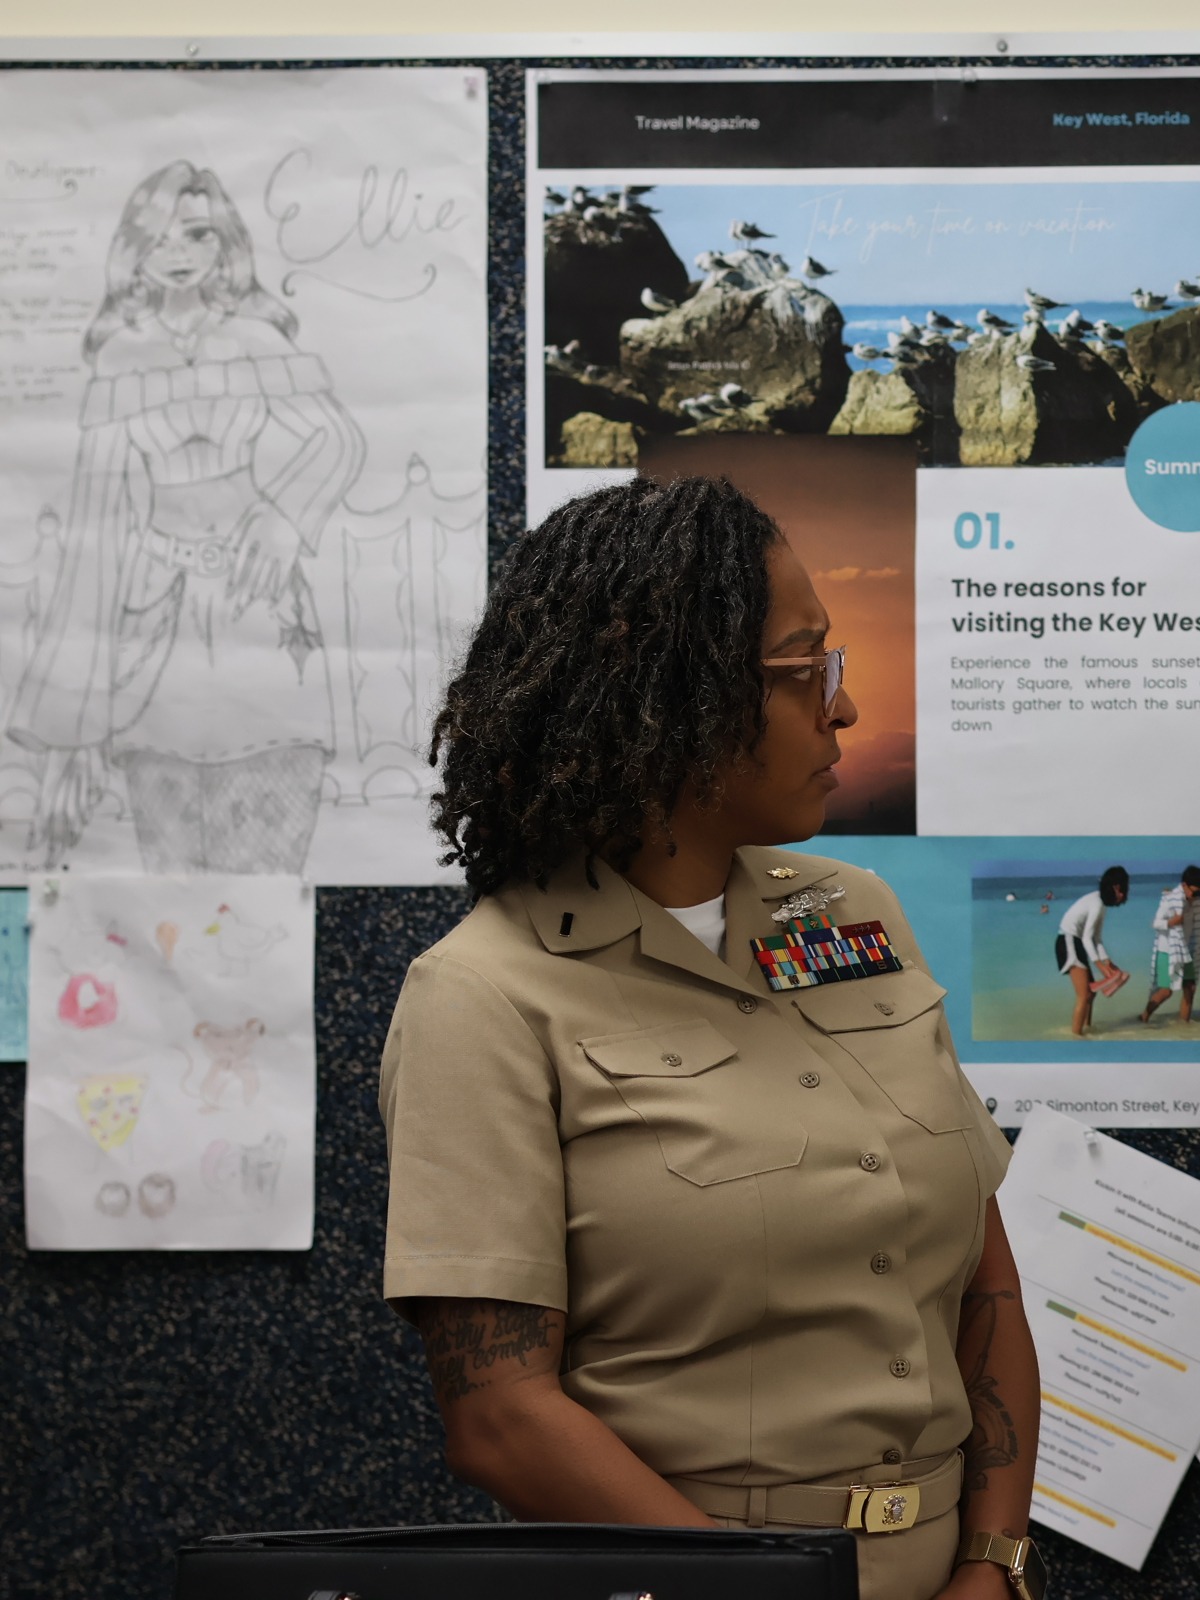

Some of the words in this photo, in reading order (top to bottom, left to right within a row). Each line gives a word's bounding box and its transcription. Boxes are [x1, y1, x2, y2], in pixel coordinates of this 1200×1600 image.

[635, 115, 683, 130] Travel
[686, 116, 760, 132] Magazine
[1052, 112, 1083, 130] Key
[1086, 112, 1133, 130] West,
[1135, 111, 1190, 126] Florida
[263, 147, 470, 263] Ellie
[800, 190, 857, 255] Take
[860, 214, 921, 264] your
[926, 201, 975, 256] time
[985, 217, 1008, 234] on
[1018, 200, 1115, 255] vacation
[953, 511, 1015, 550] 01.
[951, 579, 997, 597] The
[1004, 580, 1105, 597] reasons
[1112, 577, 1147, 597] for
[952, 612, 1045, 639] visiting
[1052, 613, 1093, 632] the
[1099, 613, 1146, 638] Key
[951, 656, 1031, 673] Experience
[1045, 656, 1068, 668] the
[1081, 656, 1138, 668] famous
[1152, 657, 1200, 668] sunset
[951, 677, 1005, 693] Mallory
[1017, 677, 1073, 693] Square,
[1085, 677, 1131, 689] where
[1143, 677, 1187, 689] locals
[951, 699, 1005, 711] tourists
[1012, 698, 1061, 714] gather
[1069, 699, 1084, 711] to
[1091, 698, 1137, 710] watch
[1145, 698, 1168, 710] the
[951, 720, 992, 732] down
[1045, 1099, 1118, 1113] Simonton
[1122, 1099, 1169, 1115] Street,
[1173, 1100, 1200, 1115] Key
[473, 1317, 558, 1369] comfort
